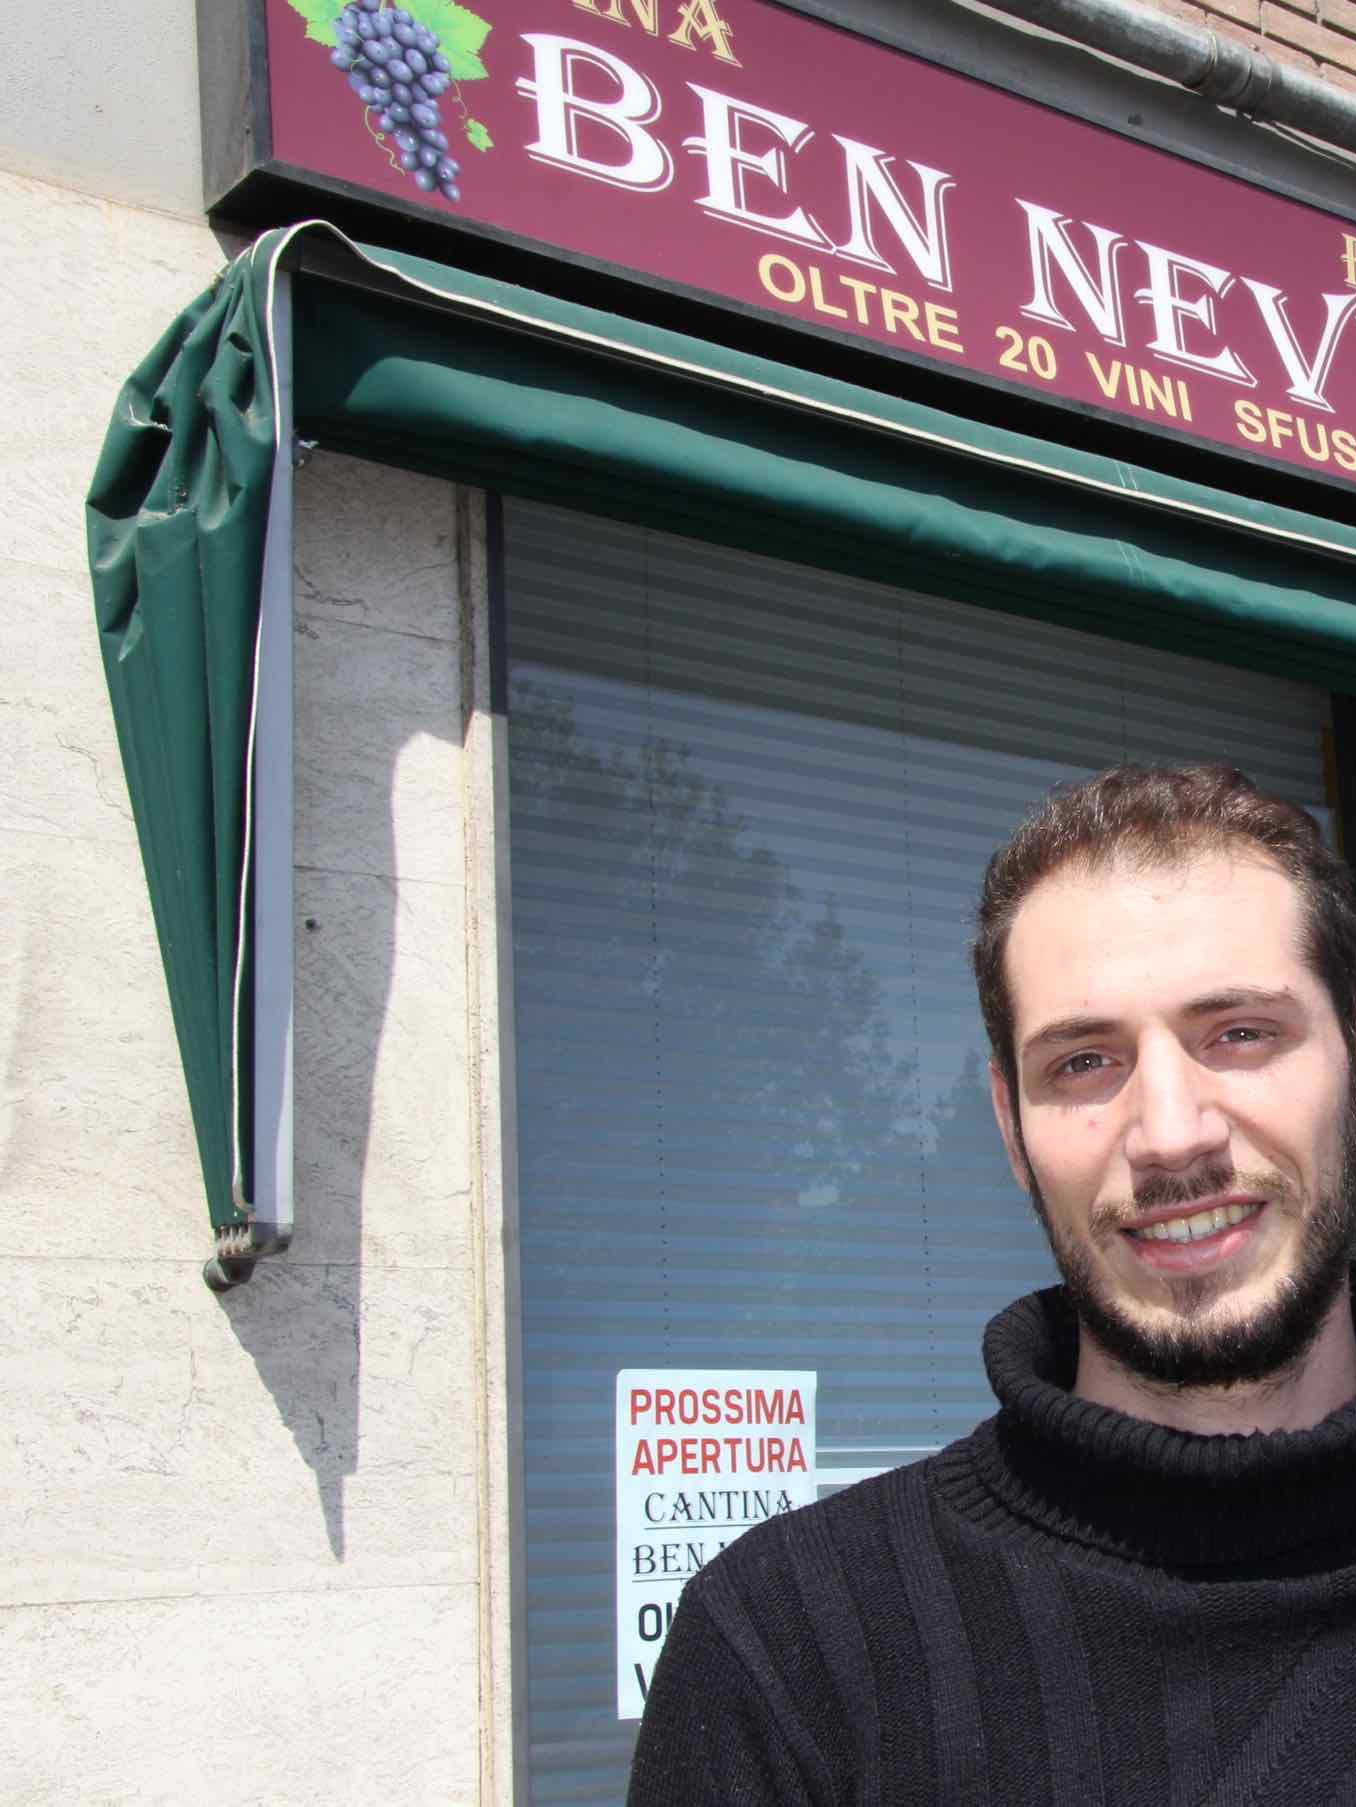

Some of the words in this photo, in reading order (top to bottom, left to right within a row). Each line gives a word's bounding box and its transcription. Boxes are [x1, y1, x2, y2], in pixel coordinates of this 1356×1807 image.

[516, 33, 956, 292] BEN
[758, 254, 964, 352] OLTRE
[995, 327, 1057, 381] 20
[1086, 352, 1193, 422] VINI
[630, 1389, 805, 1425] PROSSIMA
[631, 1438, 807, 1475] APERTURA
[645, 1489, 793, 1523] CANTINA
[632, 1542, 705, 1575] BEN
